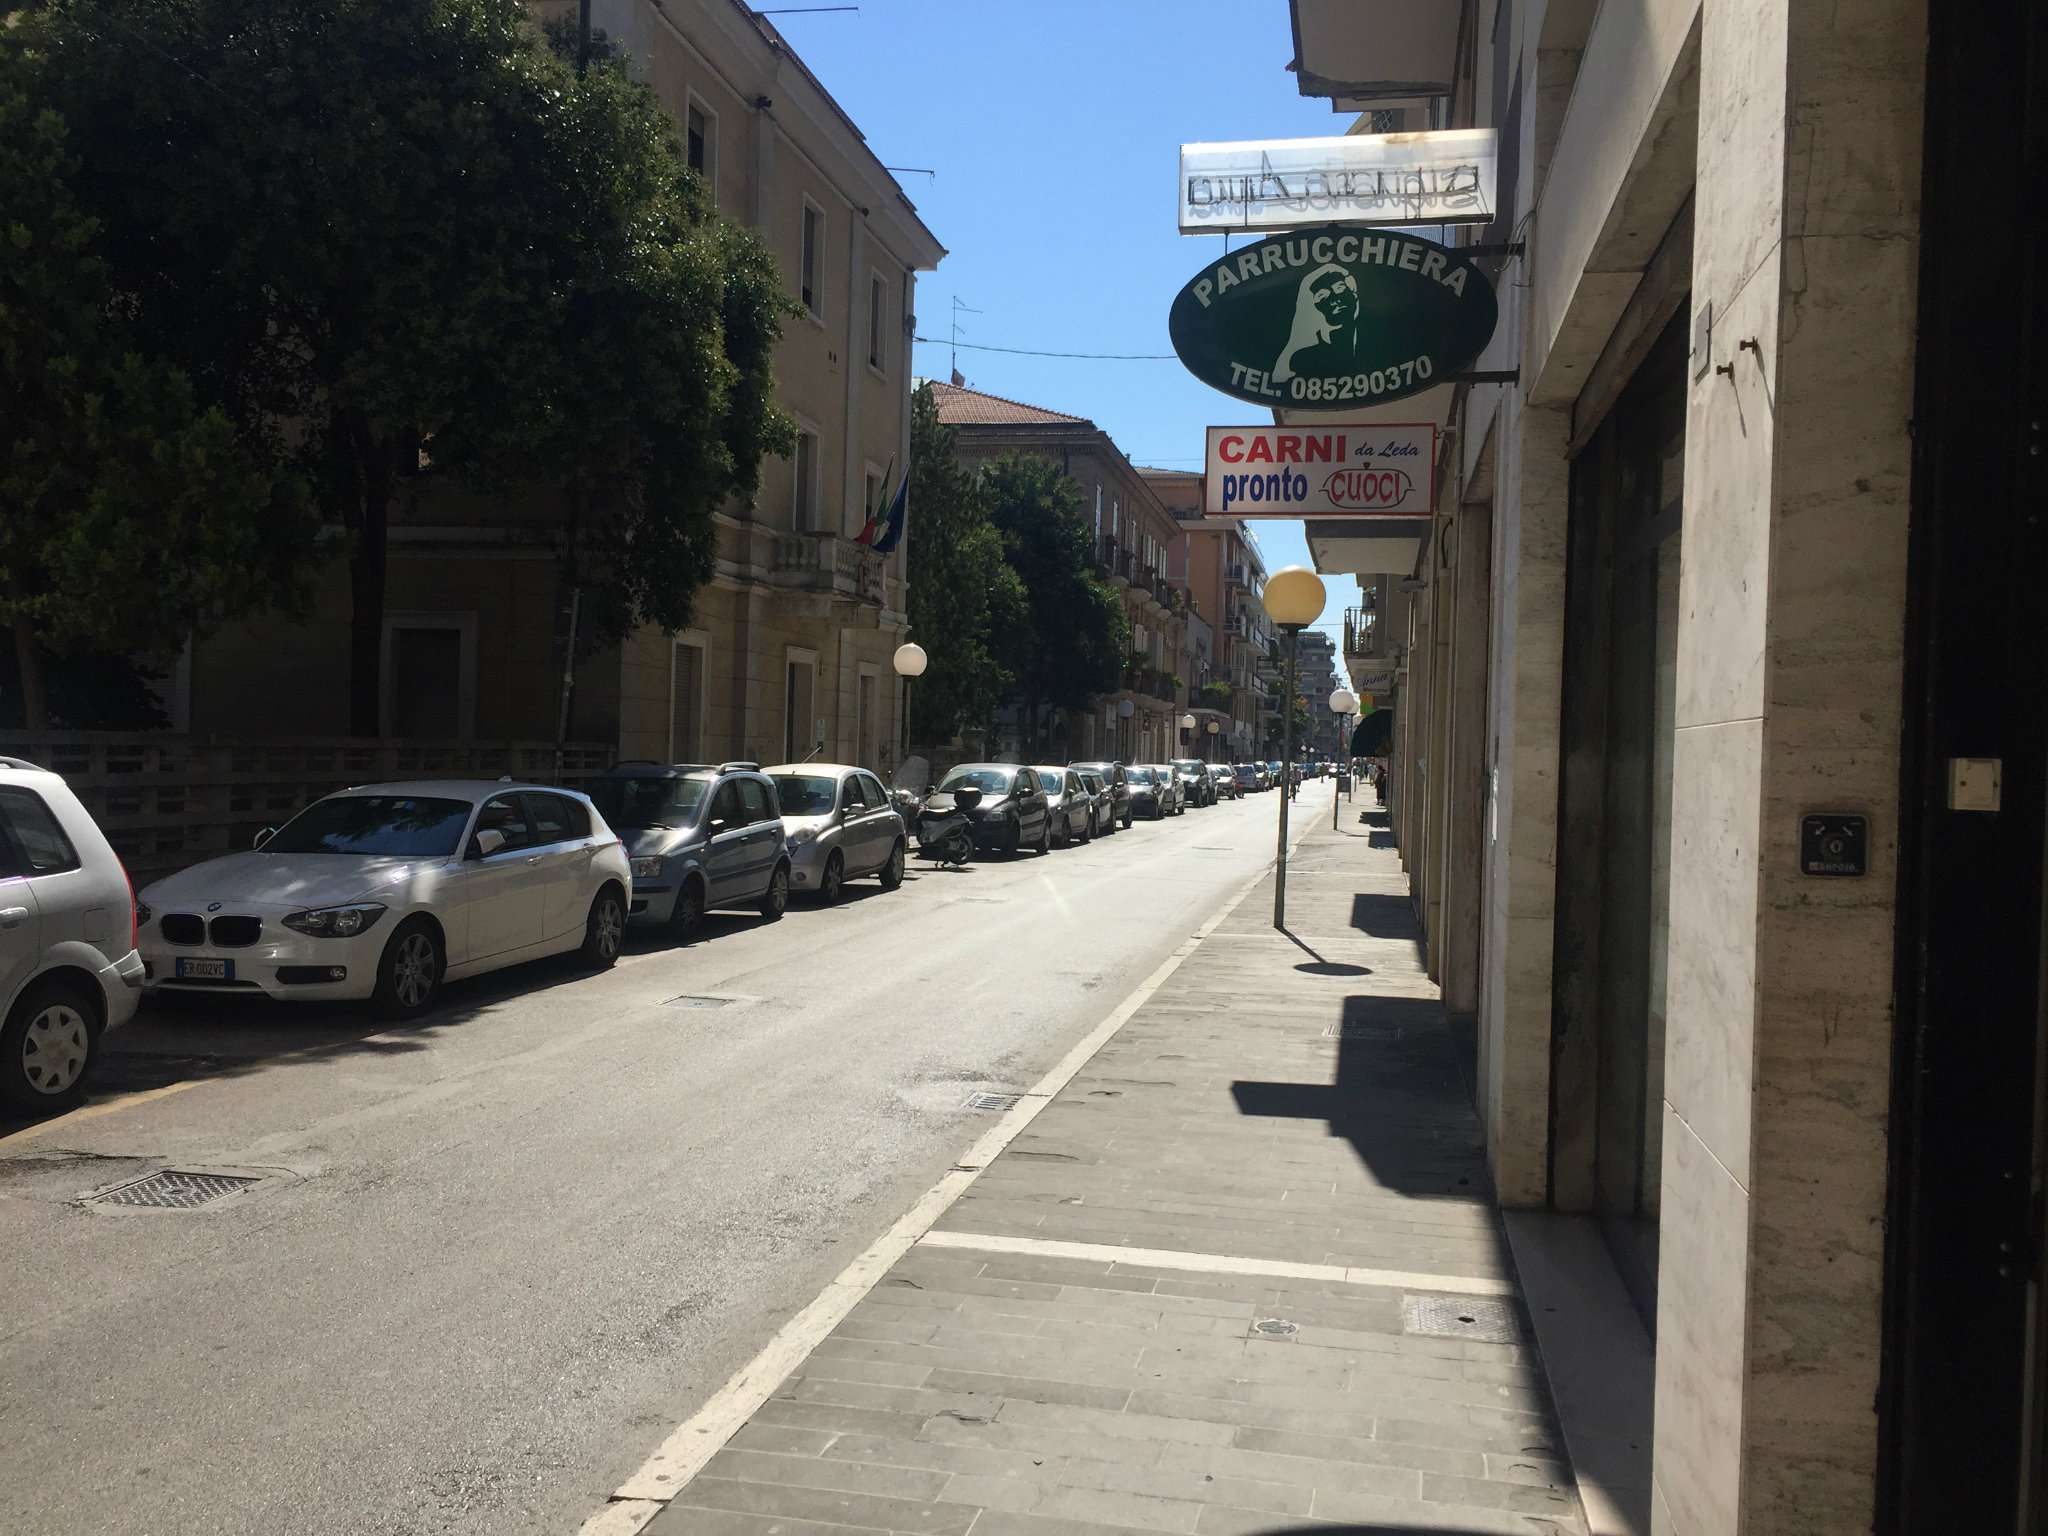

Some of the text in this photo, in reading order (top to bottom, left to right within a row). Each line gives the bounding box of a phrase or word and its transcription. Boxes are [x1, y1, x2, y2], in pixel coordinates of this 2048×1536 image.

[1192, 235, 1470, 309] PARRUCCHIERA
[1230, 355, 1433, 400] TEL. 085290370
[1219, 434, 1420, 463] CARNI da Leda
[1222, 465, 1308, 511] pronto
